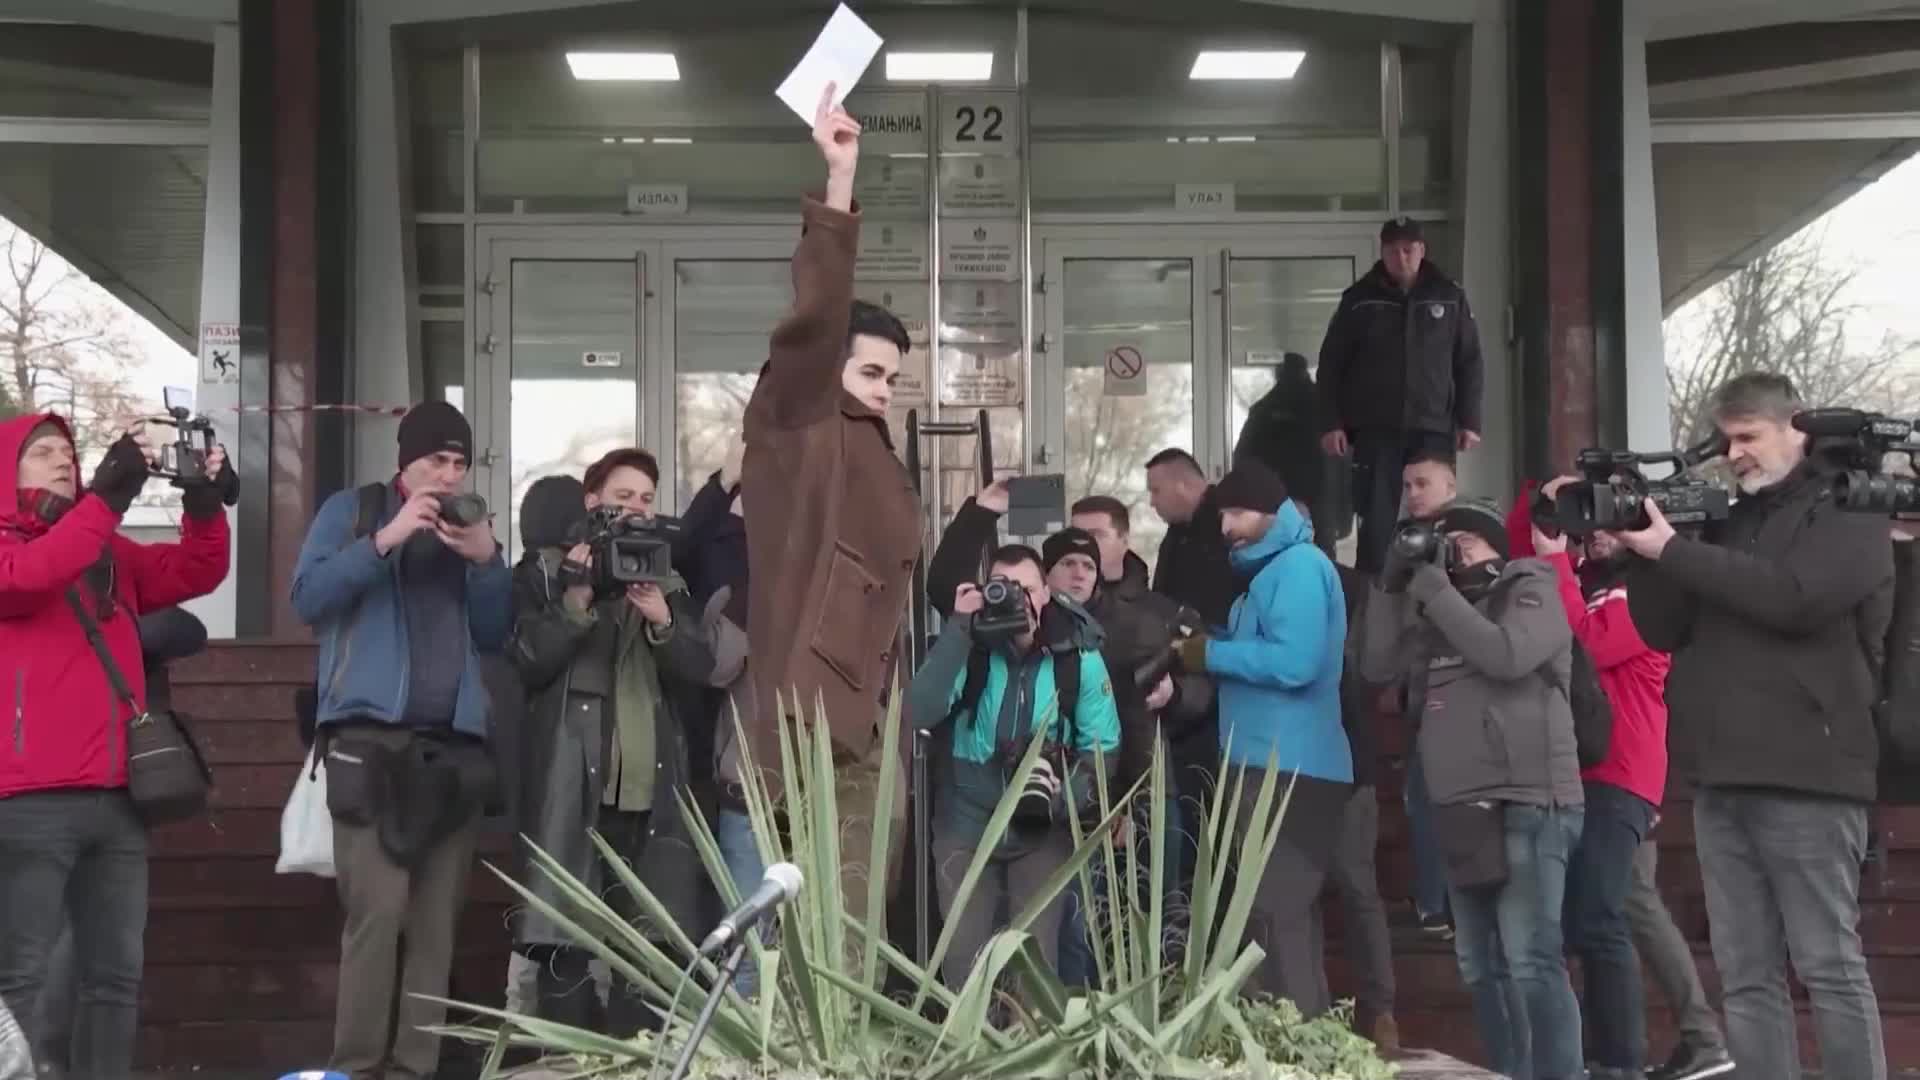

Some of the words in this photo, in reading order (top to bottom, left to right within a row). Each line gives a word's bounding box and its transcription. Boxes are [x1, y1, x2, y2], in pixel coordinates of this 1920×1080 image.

[862, 115, 922, 133] ЕМАЊИНА
[956, 106, 1003, 142] 22
[638, 193, 678, 205] ИЗЛАЗ
[1188, 192, 1223, 204] УЛАЗ
